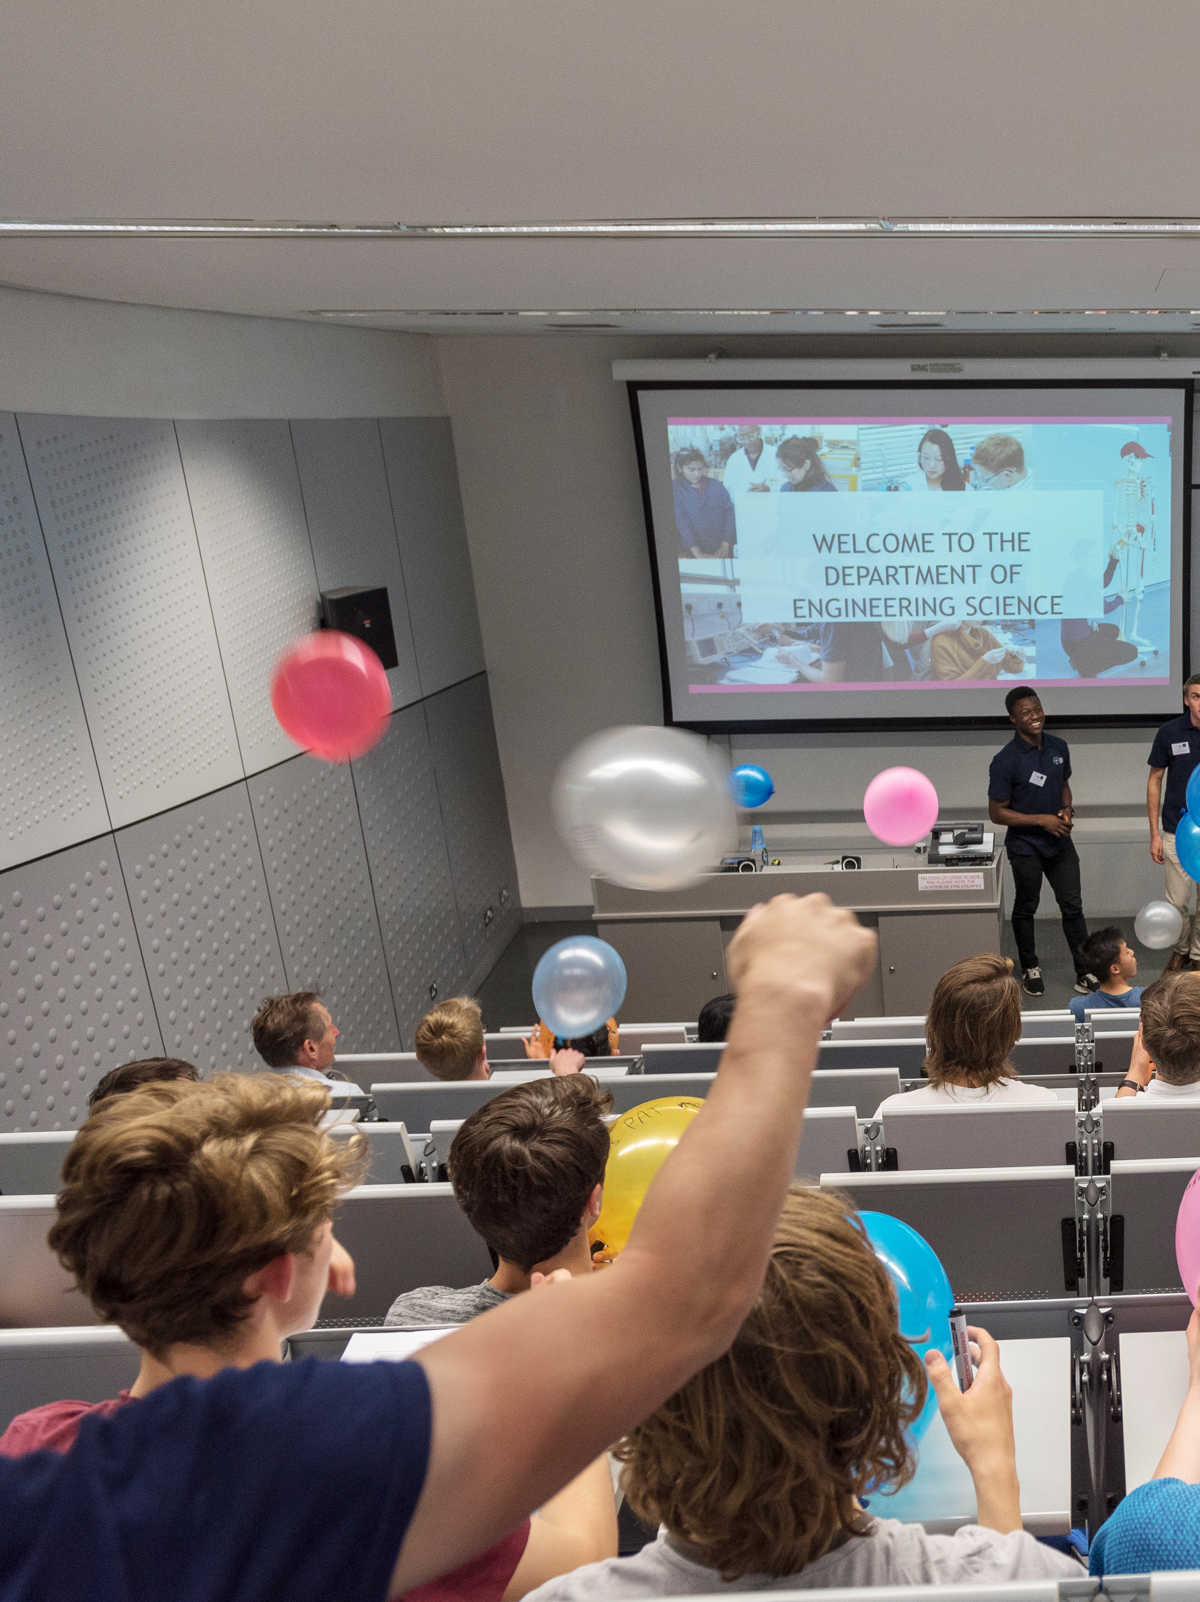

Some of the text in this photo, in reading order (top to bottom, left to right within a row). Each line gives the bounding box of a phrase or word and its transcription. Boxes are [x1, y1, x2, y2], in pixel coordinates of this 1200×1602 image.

[812, 531, 1031, 554] WELCOME TO THE
[824, 564, 1023, 586] DEPARTMENT OF
[792, 595, 1065, 619] ENGINEERING SCIENCE
